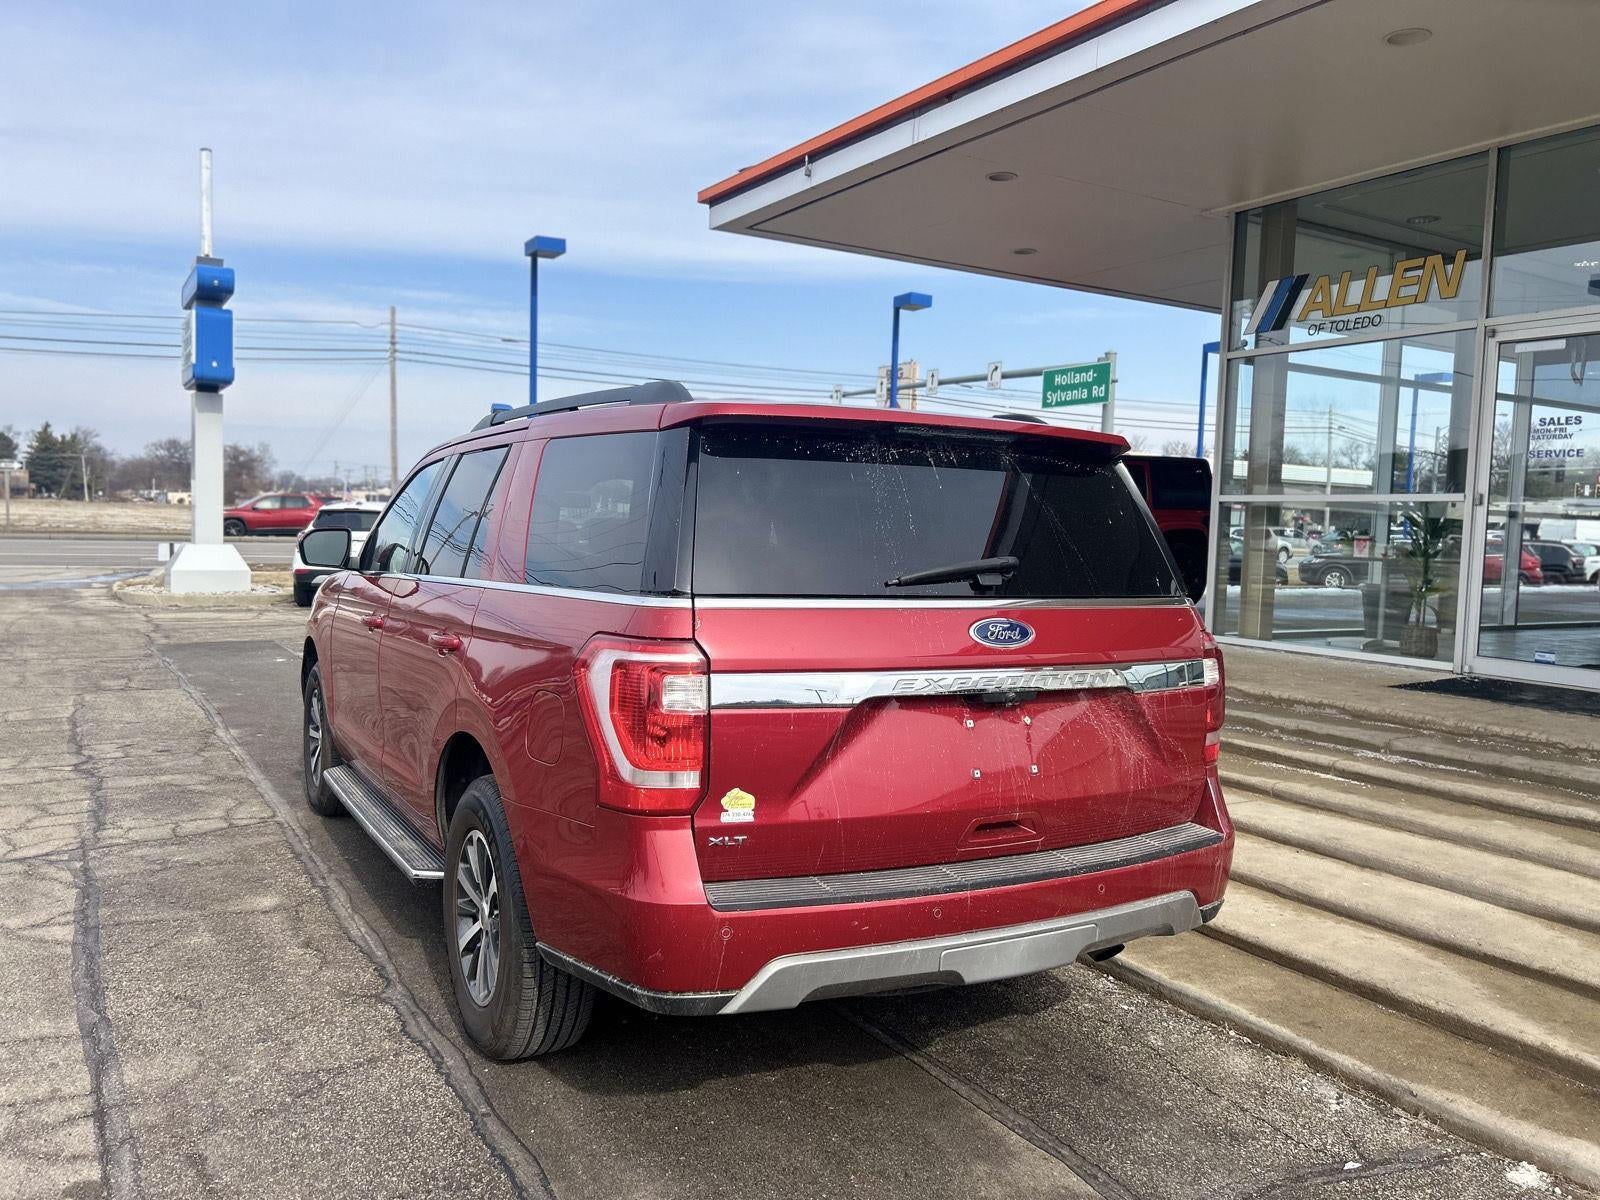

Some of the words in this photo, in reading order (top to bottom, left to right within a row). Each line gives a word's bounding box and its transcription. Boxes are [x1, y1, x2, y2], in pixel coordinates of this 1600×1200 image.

[1296, 248, 1467, 322] ALLEN
[1307, 322, 1326, 336] OF
[1329, 314, 1382, 333] TOLEDO
[1054, 368, 1097, 386] Holland-
[1046, 387, 1088, 406] Sylvania
[1092, 384, 1105, 398] Rd
[1538, 415, 1583, 427] SALES
[1530, 433, 1574, 441] SATURDAY
[1532, 427, 1568, 435] MON-FRI
[1528, 448, 1585, 459] SERVICE
[987, 623, 1021, 640] Ford
[891, 671, 1112, 693] EXPEDITION
[708, 835, 748, 846] XLT
